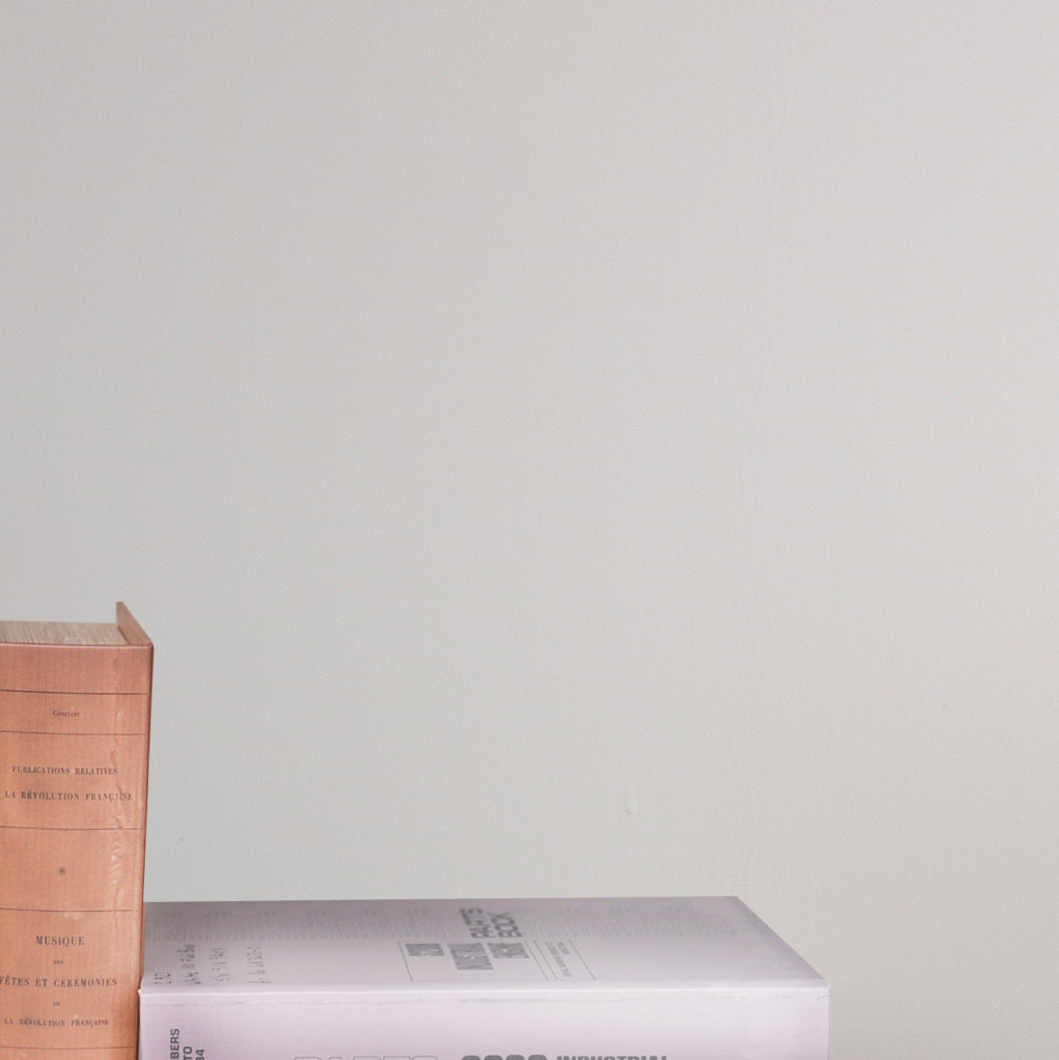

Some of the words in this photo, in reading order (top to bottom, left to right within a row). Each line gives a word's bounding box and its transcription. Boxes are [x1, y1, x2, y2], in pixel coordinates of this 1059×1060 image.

[12, 765, 71, 775] PUBLICATIONS
[75, 767, 118, 776] RELATIVES
[5, 789, 17, 798] LA
[36, 935, 85, 947] MUSIQUE
[35, 978, 48, 987] ET
[4, 1017, 14, 1025] LA
